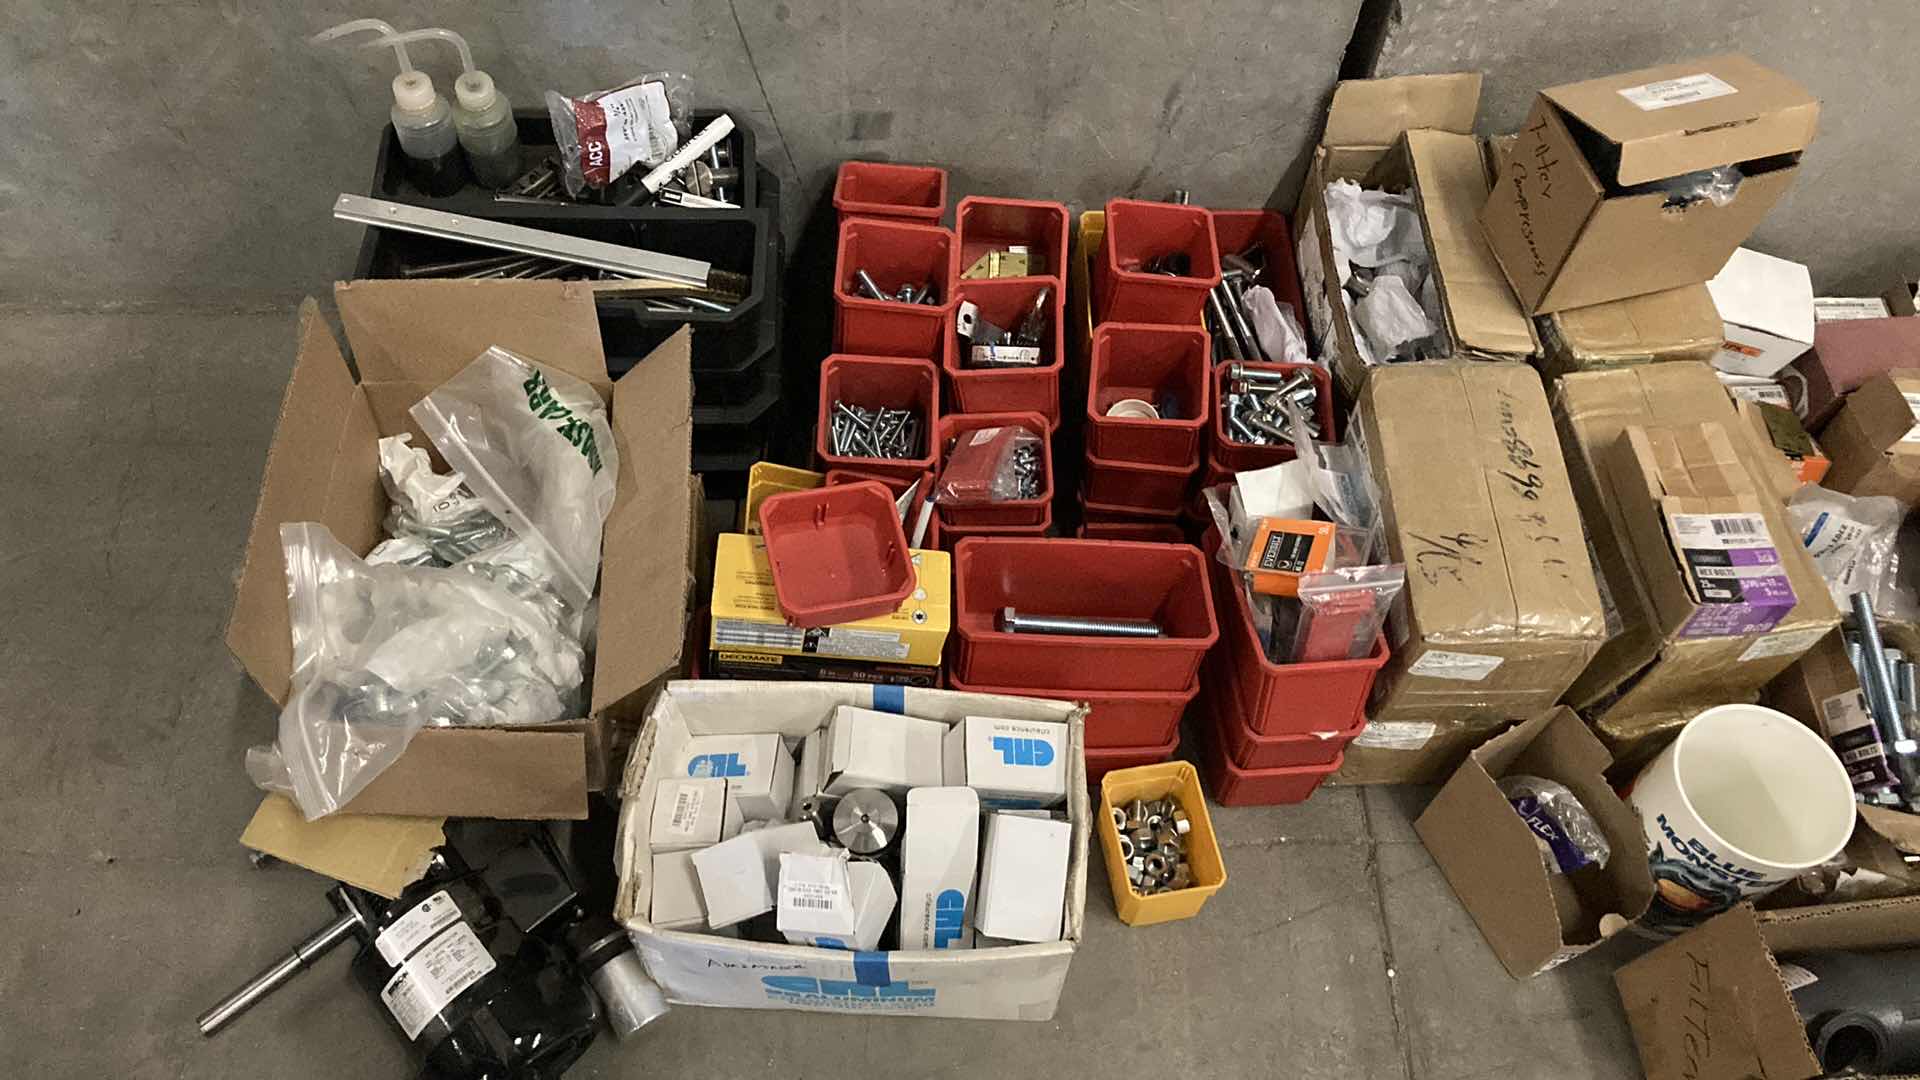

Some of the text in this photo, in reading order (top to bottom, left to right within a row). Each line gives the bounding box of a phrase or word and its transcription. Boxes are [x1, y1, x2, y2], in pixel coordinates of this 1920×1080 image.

[720, 653, 778, 663] DECKMATE
[992, 736, 1055, 767] CRL
[1526, 815, 1560, 841] FLEX
[1687, 837, 1768, 880] BLUE
[933, 888, 965, 949] CRL
